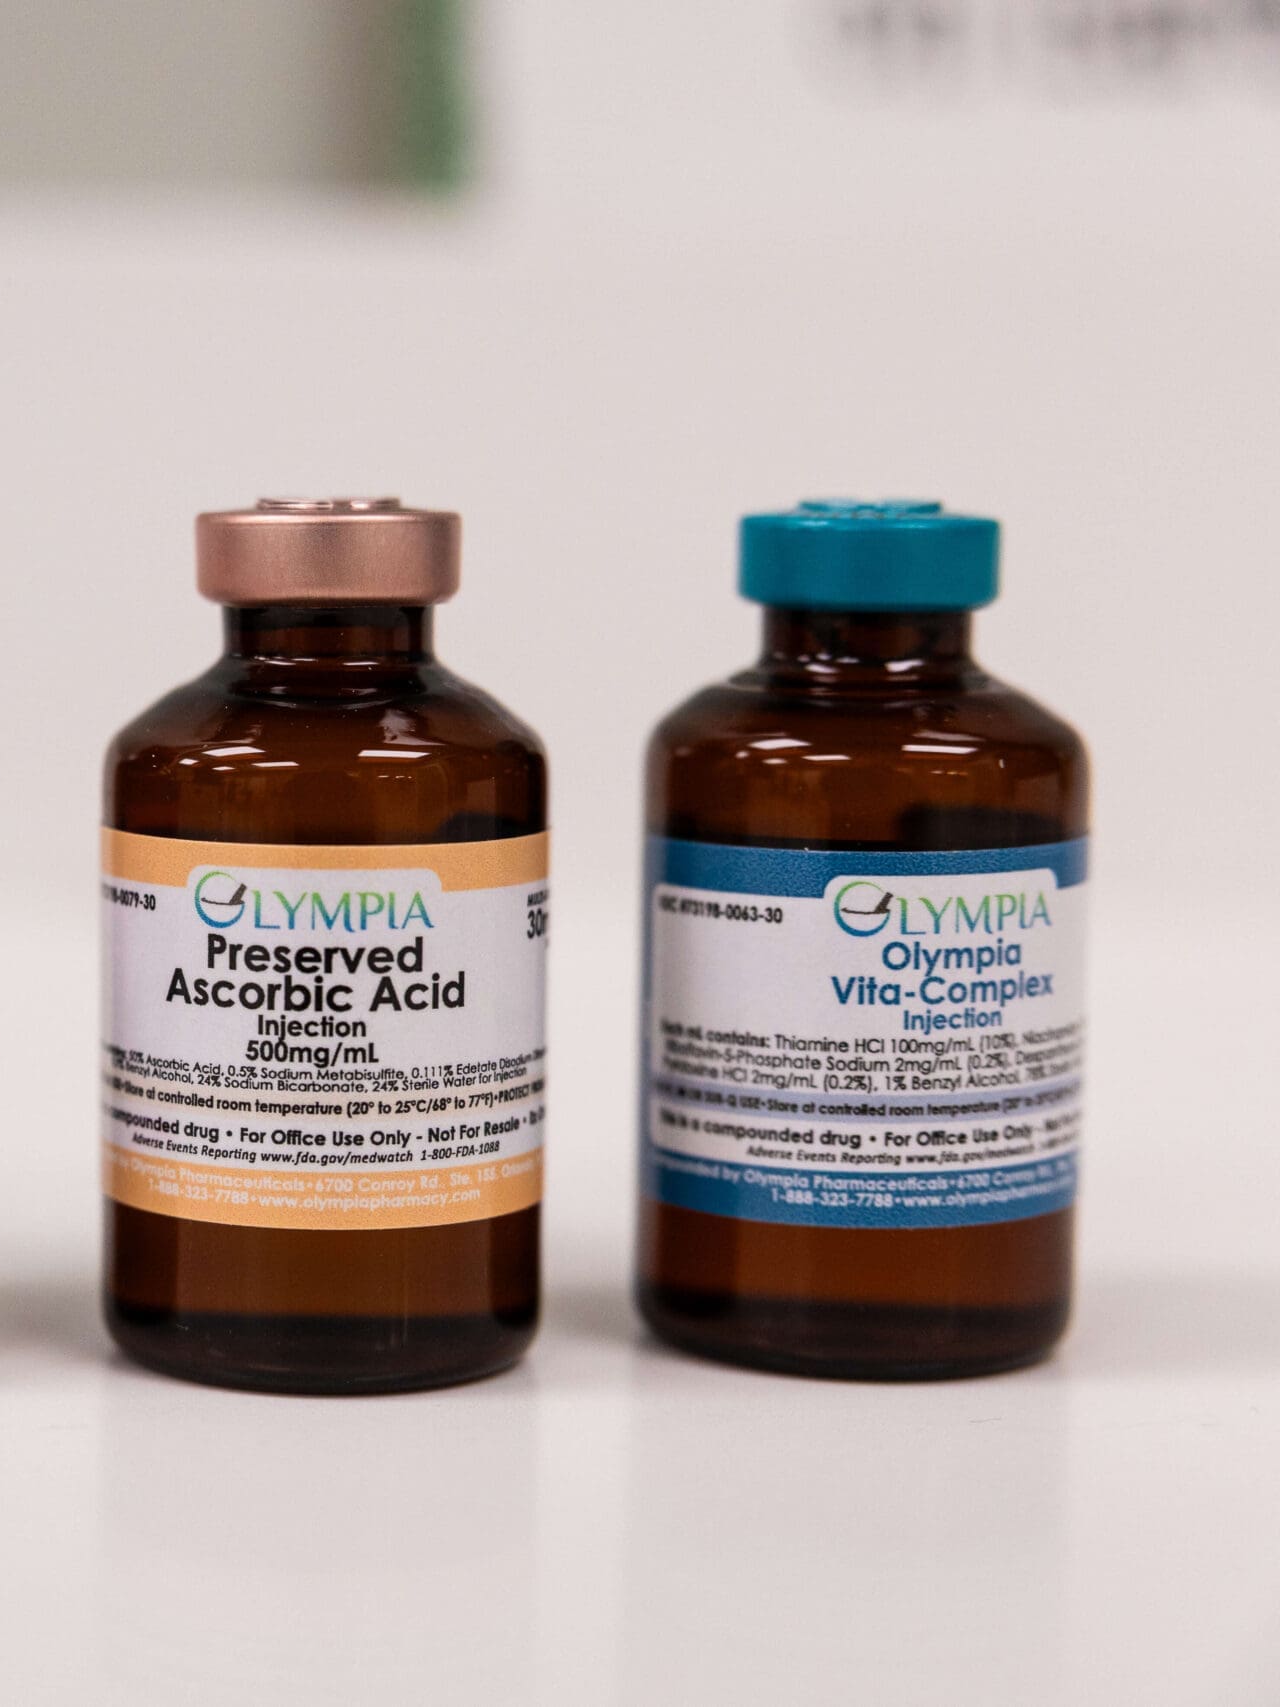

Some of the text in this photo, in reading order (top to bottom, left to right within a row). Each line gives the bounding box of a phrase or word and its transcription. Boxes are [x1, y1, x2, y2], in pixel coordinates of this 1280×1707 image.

[207, 934, 424, 973] Preserved
[882, 938, 1021, 977] Olympia
[166, 968, 465, 1012] Ascorbic Acid
[832, 971, 1053, 1007] Vita-Complex
[258, 1015, 366, 1040] Injection
[904, 1007, 1002, 1034] Injection
[245, 1040, 379, 1068] 500mg/mL
[775, 1034, 974, 1055] Thiamine HCl 100mg/mL
[147, 1055, 190, 1072] Ascorbic
[193, 1063, 224, 1077] Acid,
[228, 1065, 257, 1078] 0.5%
[261, 1067, 312, 1080] Sodium
[317, 1069, 408, 1081] Metabisulfite,
[412, 1065, 453, 1079] 0.111%
[456, 1061, 497, 1075] Edetate
[826, 1056, 961, 1074] Sodium 2mg/mL
[152, 1065, 527, 1094] Alcohol, 24% Sodium Bicarbonate, 24% Sterile Water for Injection
[752, 1070, 961, 1091] 2mg/mL 1% Benzyl
[157, 1089, 465, 1116] controlled room temperature to to
[803, 1101, 999, 1117] at controlled room temperature
[184, 1122, 219, 1142] drug
[240, 1128, 266, 1143] For
[271, 1129, 326, 1147] Office
[332, 1132, 364, 1146] Use
[370, 1130, 411, 1148] Only
[428, 1128, 456, 1143] Not
[460, 1125, 480, 1139] For
[484, 1116, 519, 1135] Resale
[703, 1120, 998, 1149] compounded drug For Office Use
[133, 1133, 499, 1166] Adverse Events Reporting www.fda.gov/medwatch 1-800-FDA-1088
[747, 1146, 901, 1166] Adverse Events Reporting
[358, 1177, 415, 1193] Conroy
[723, 1166, 739, 1183] by
[743, 1168, 809, 1188] Olympia
